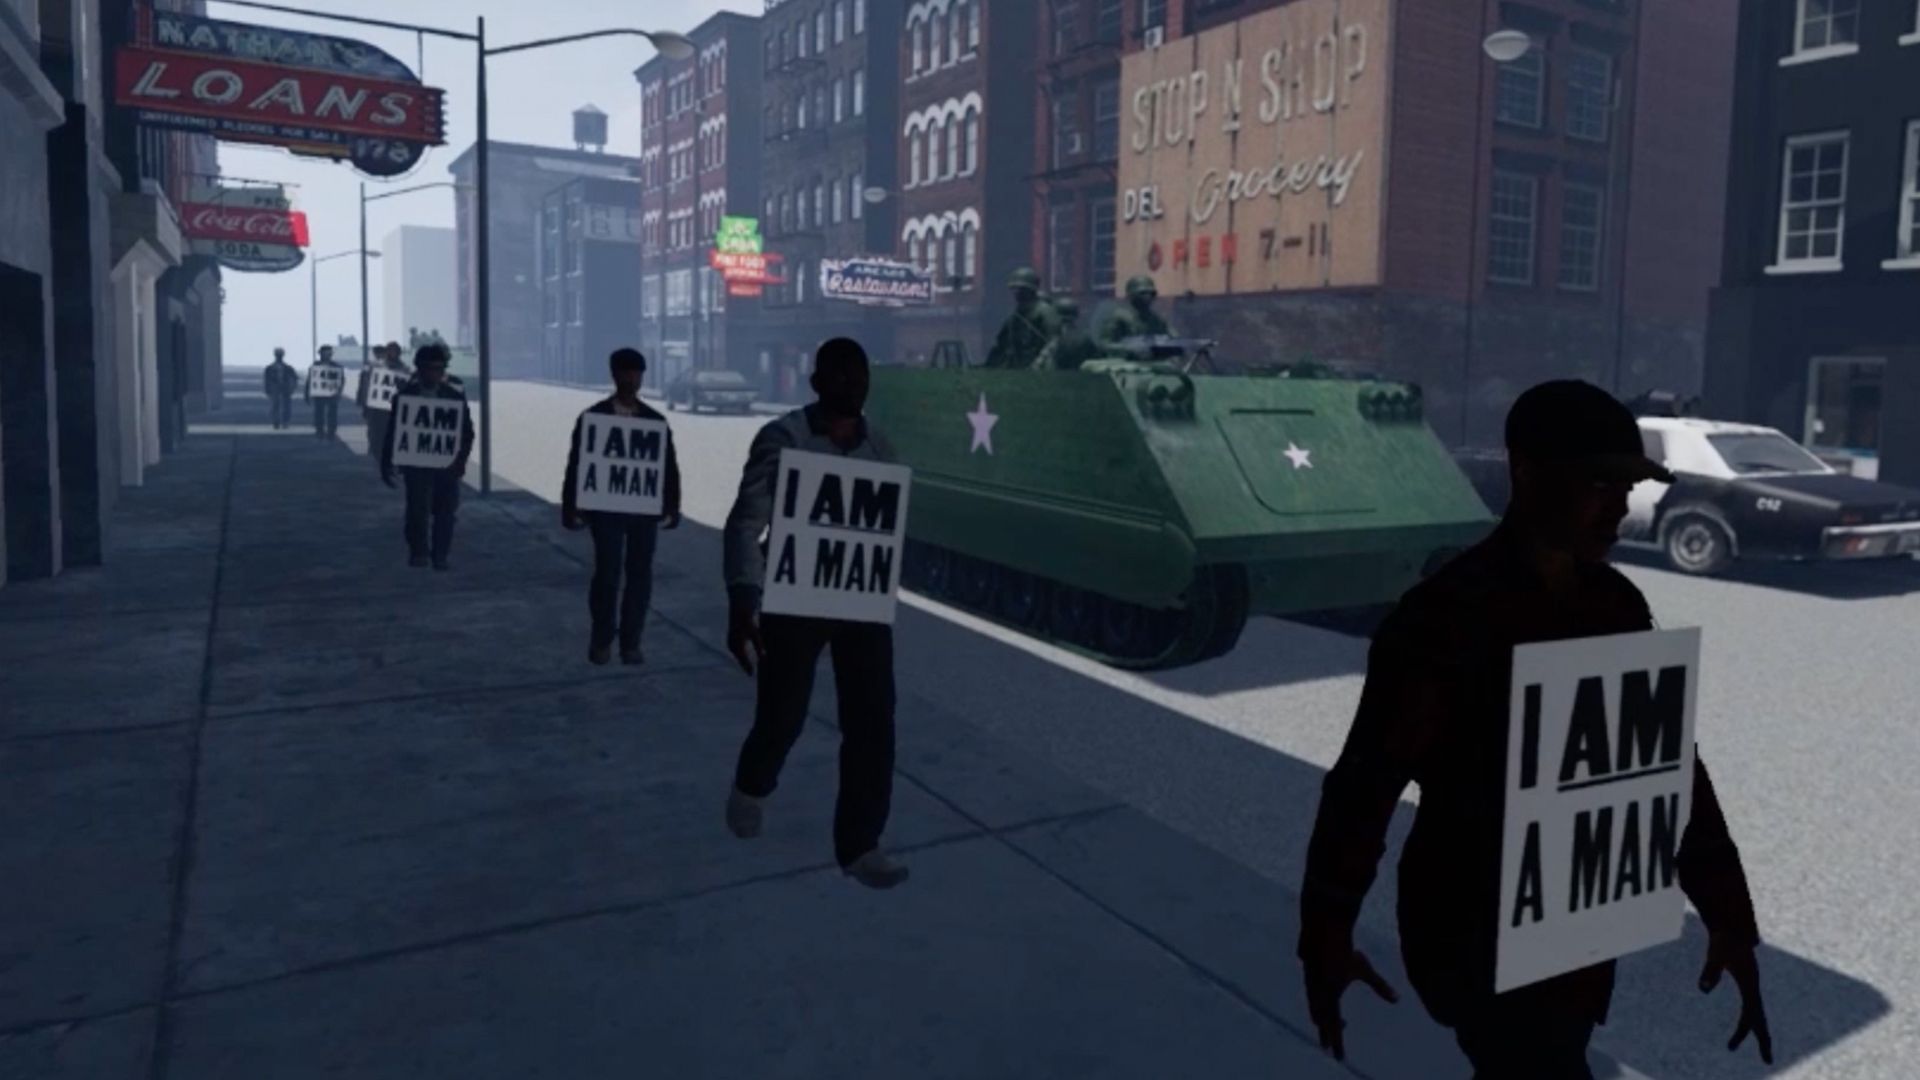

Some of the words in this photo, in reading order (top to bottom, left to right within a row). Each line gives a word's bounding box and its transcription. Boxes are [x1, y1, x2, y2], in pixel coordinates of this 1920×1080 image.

[157, 19, 369, 69] NATHAN'S
[130, 61, 414, 125] LOANS
[1132, 71, 1209, 153] STOP
[1222, 58, 1243, 120] N
[1258, 23, 1367, 124] SHOP
[356, 138, 412, 163] 178
[1124, 186, 1163, 223] DEL
[1191, 151, 1363, 224] Grocery
[1148, 234, 1238, 272] OPEN
[829, 273, 929, 298] Restaurant
[402, 404, 409, 425] I
[413, 405, 459, 431] AM
[398, 430, 409, 454] A
[416, 432, 456, 456] MAN
[586, 424, 597, 454] I
[602, 426, 661, 462] AM
[583, 462, 597, 493] A
[607, 464, 659, 498] MAN
[783, 467, 800, 519] I
[808, 472, 901, 532] AM
[774, 533, 796, 585] A
[813, 537, 894, 594] MAN
[1519, 683, 1542, 790] I
[1557, 665, 1687, 785] AM
[1511, 820, 1544, 928] A
[1568, 792, 1681, 913] MAN
